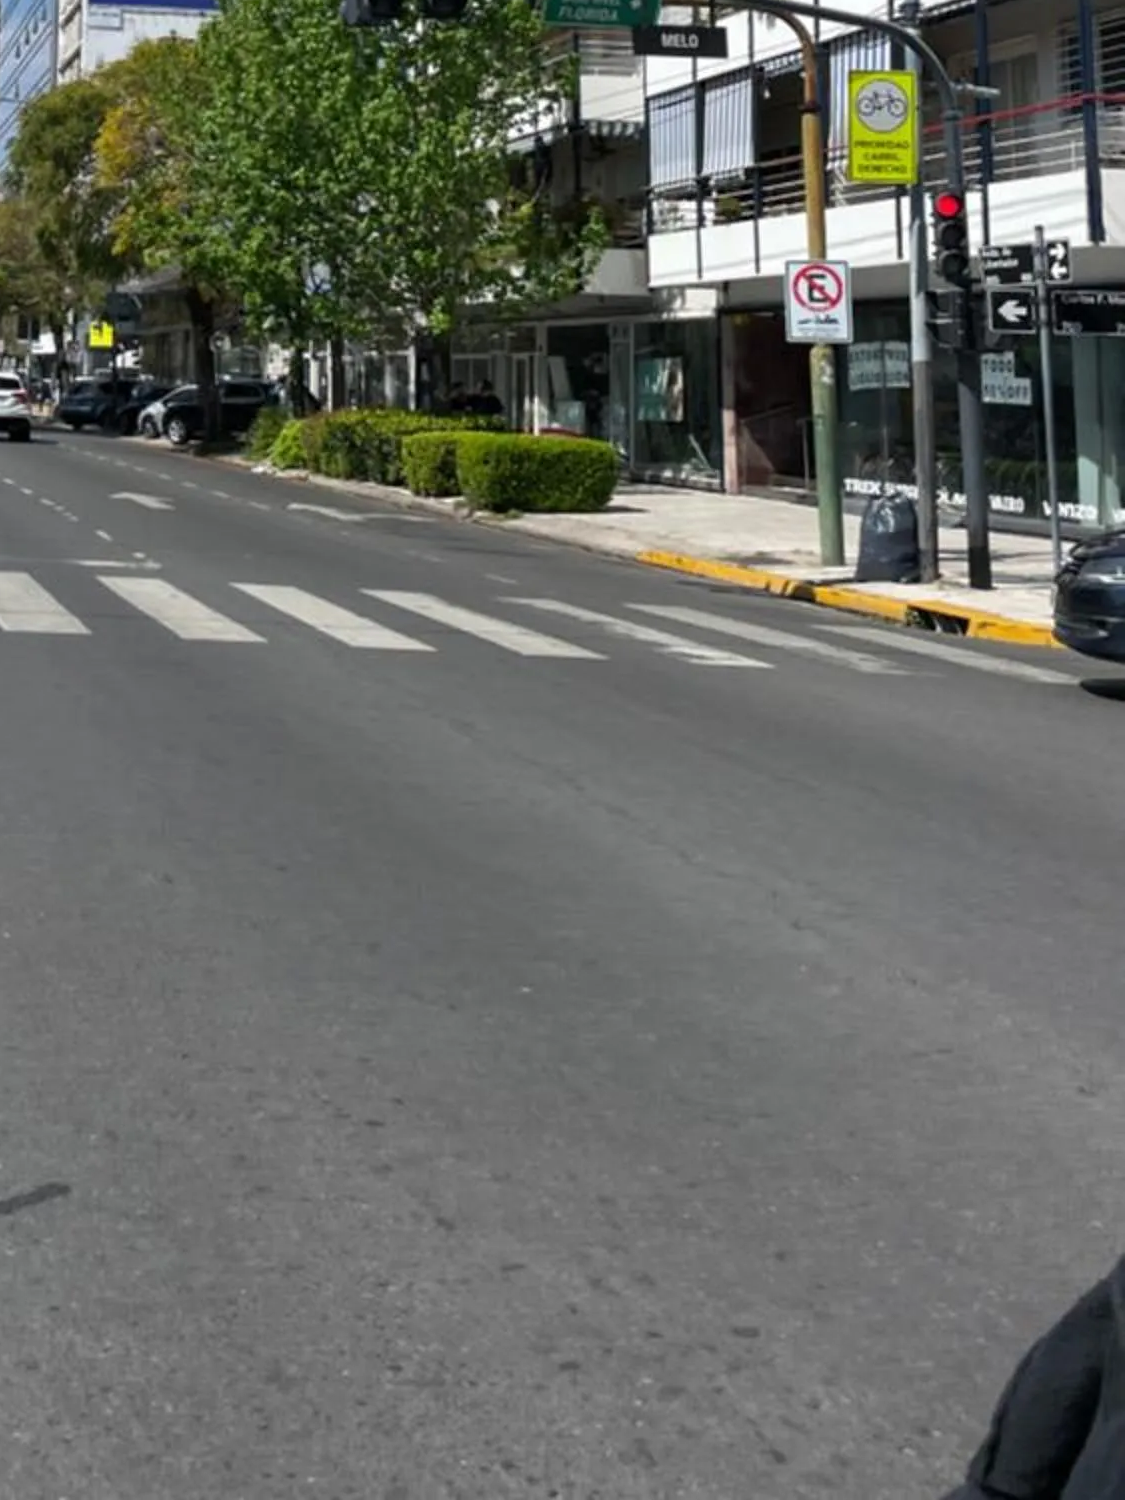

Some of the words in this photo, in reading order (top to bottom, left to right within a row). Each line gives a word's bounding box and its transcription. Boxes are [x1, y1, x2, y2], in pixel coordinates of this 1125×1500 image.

[558, 6, 619, 21] FLORIDA
[661, 33, 699, 48] MELO
[808, 274, 829, 303] E
[1042, 500, 1097, 520] VNZO
